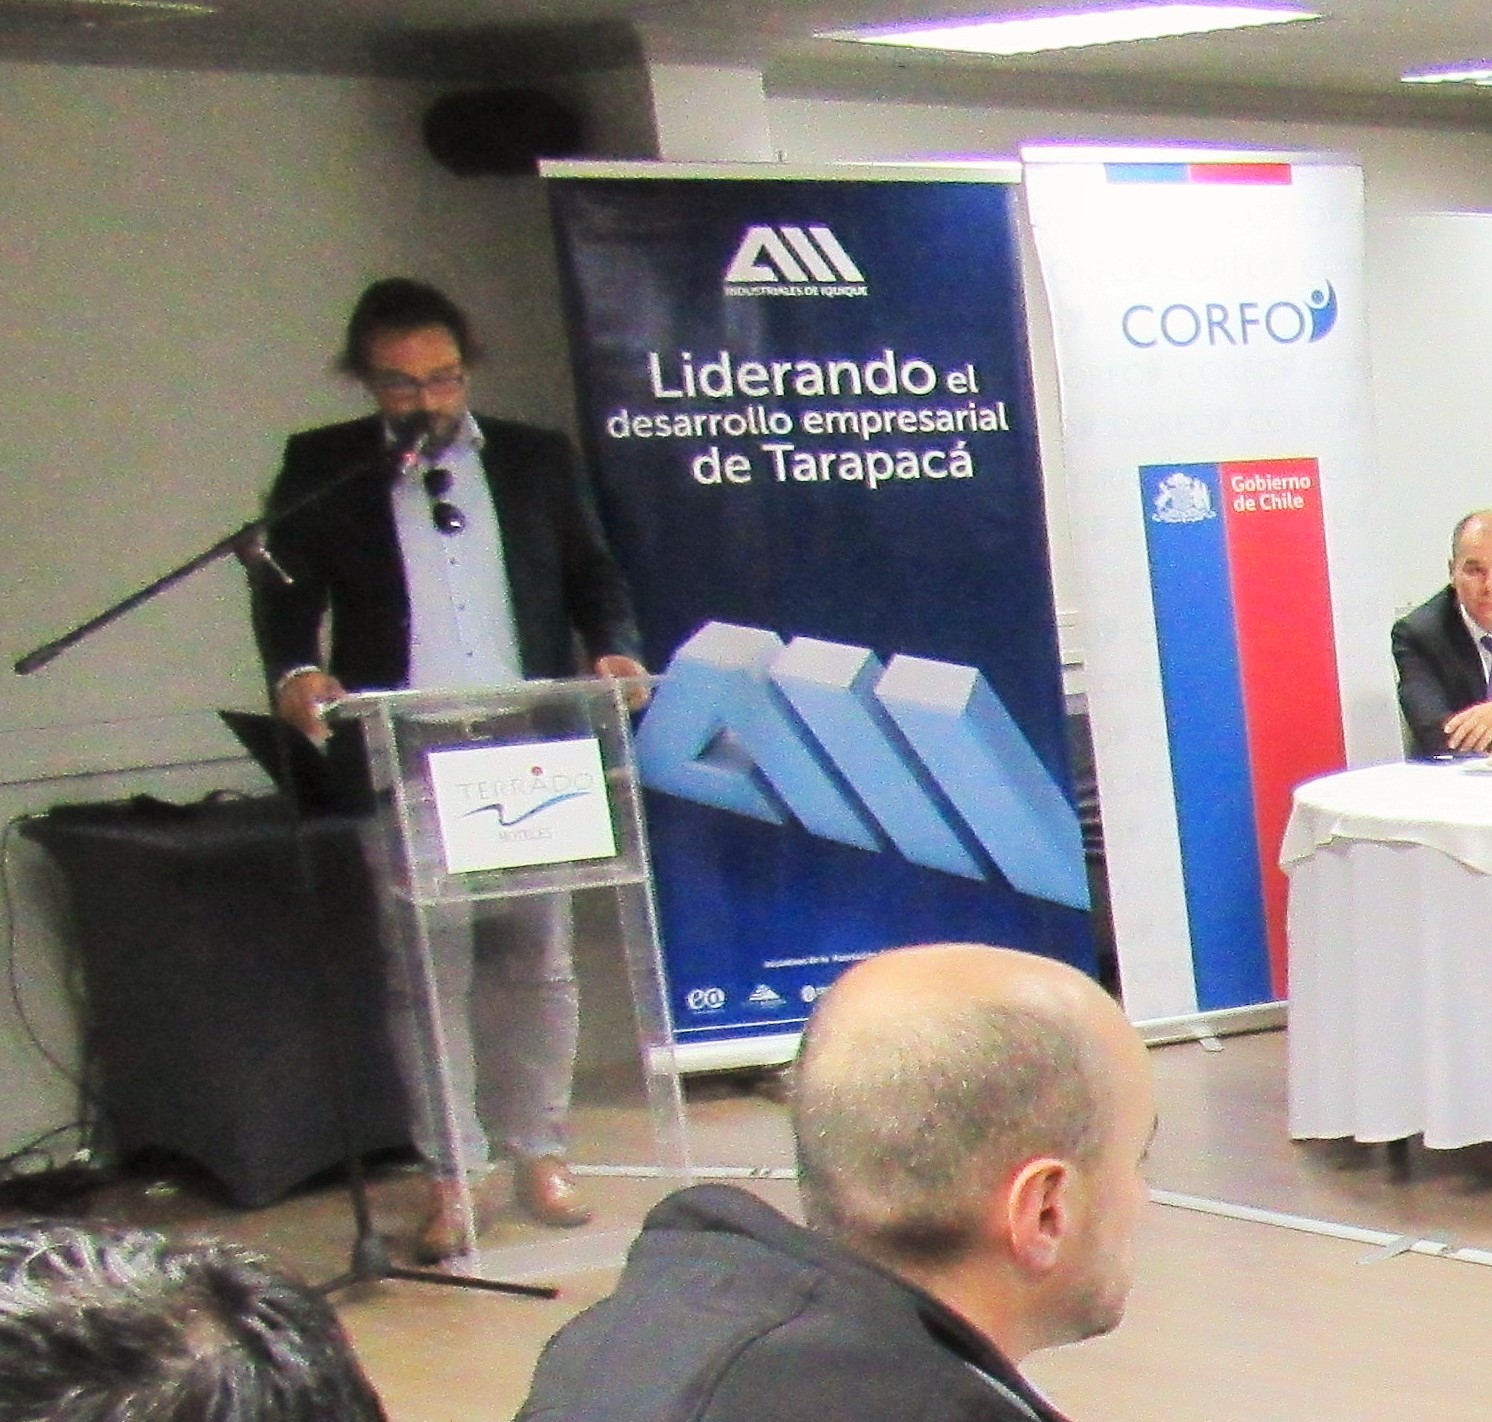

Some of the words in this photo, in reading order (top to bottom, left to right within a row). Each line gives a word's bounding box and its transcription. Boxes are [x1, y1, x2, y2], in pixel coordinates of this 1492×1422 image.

[1122, 301, 1305, 349] CORFO
[649, 349, 936, 399] Liderando
[948, 363, 979, 394] el
[606, 405, 793, 439] desarrollo
[803, 402, 1009, 440] empresarial
[692, 447, 752, 484] de
[760, 440, 974, 488] Tarapacá
[1231, 472, 1311, 492] Gobierno
[1233, 494, 1256, 512] de
[1260, 491, 1305, 511] Chile
